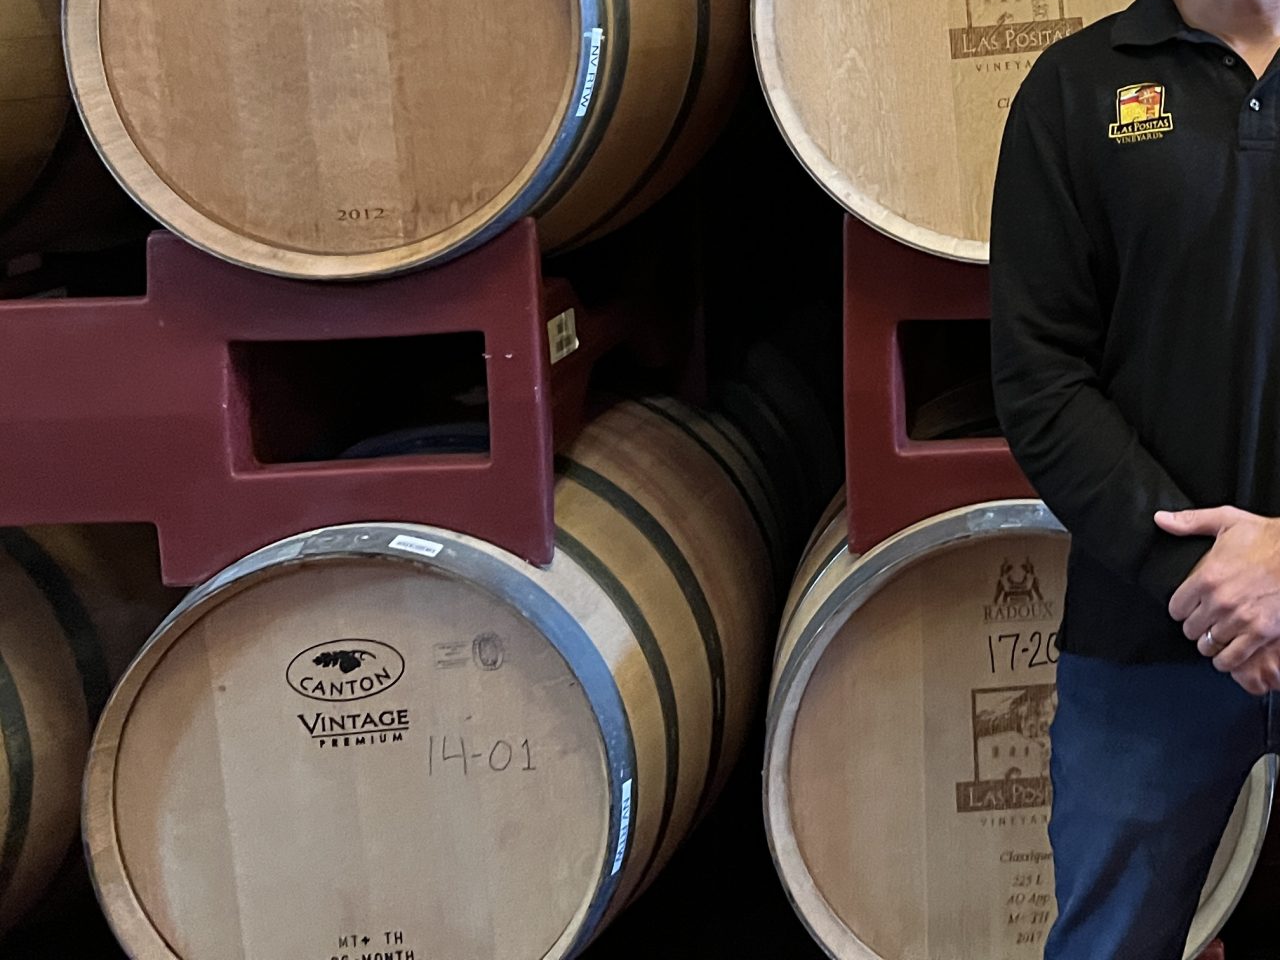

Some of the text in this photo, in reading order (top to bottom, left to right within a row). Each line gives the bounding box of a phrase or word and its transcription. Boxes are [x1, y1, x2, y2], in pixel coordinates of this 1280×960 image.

[337, 208, 385, 221] 2012
[983, 602, 1054, 620] RADOUX
[299, 666, 392, 697] CANTON
[319, 732, 404, 749] PREMIUM
[428, 735, 537, 777] 14-01
[384, 930, 404, 945] TH
